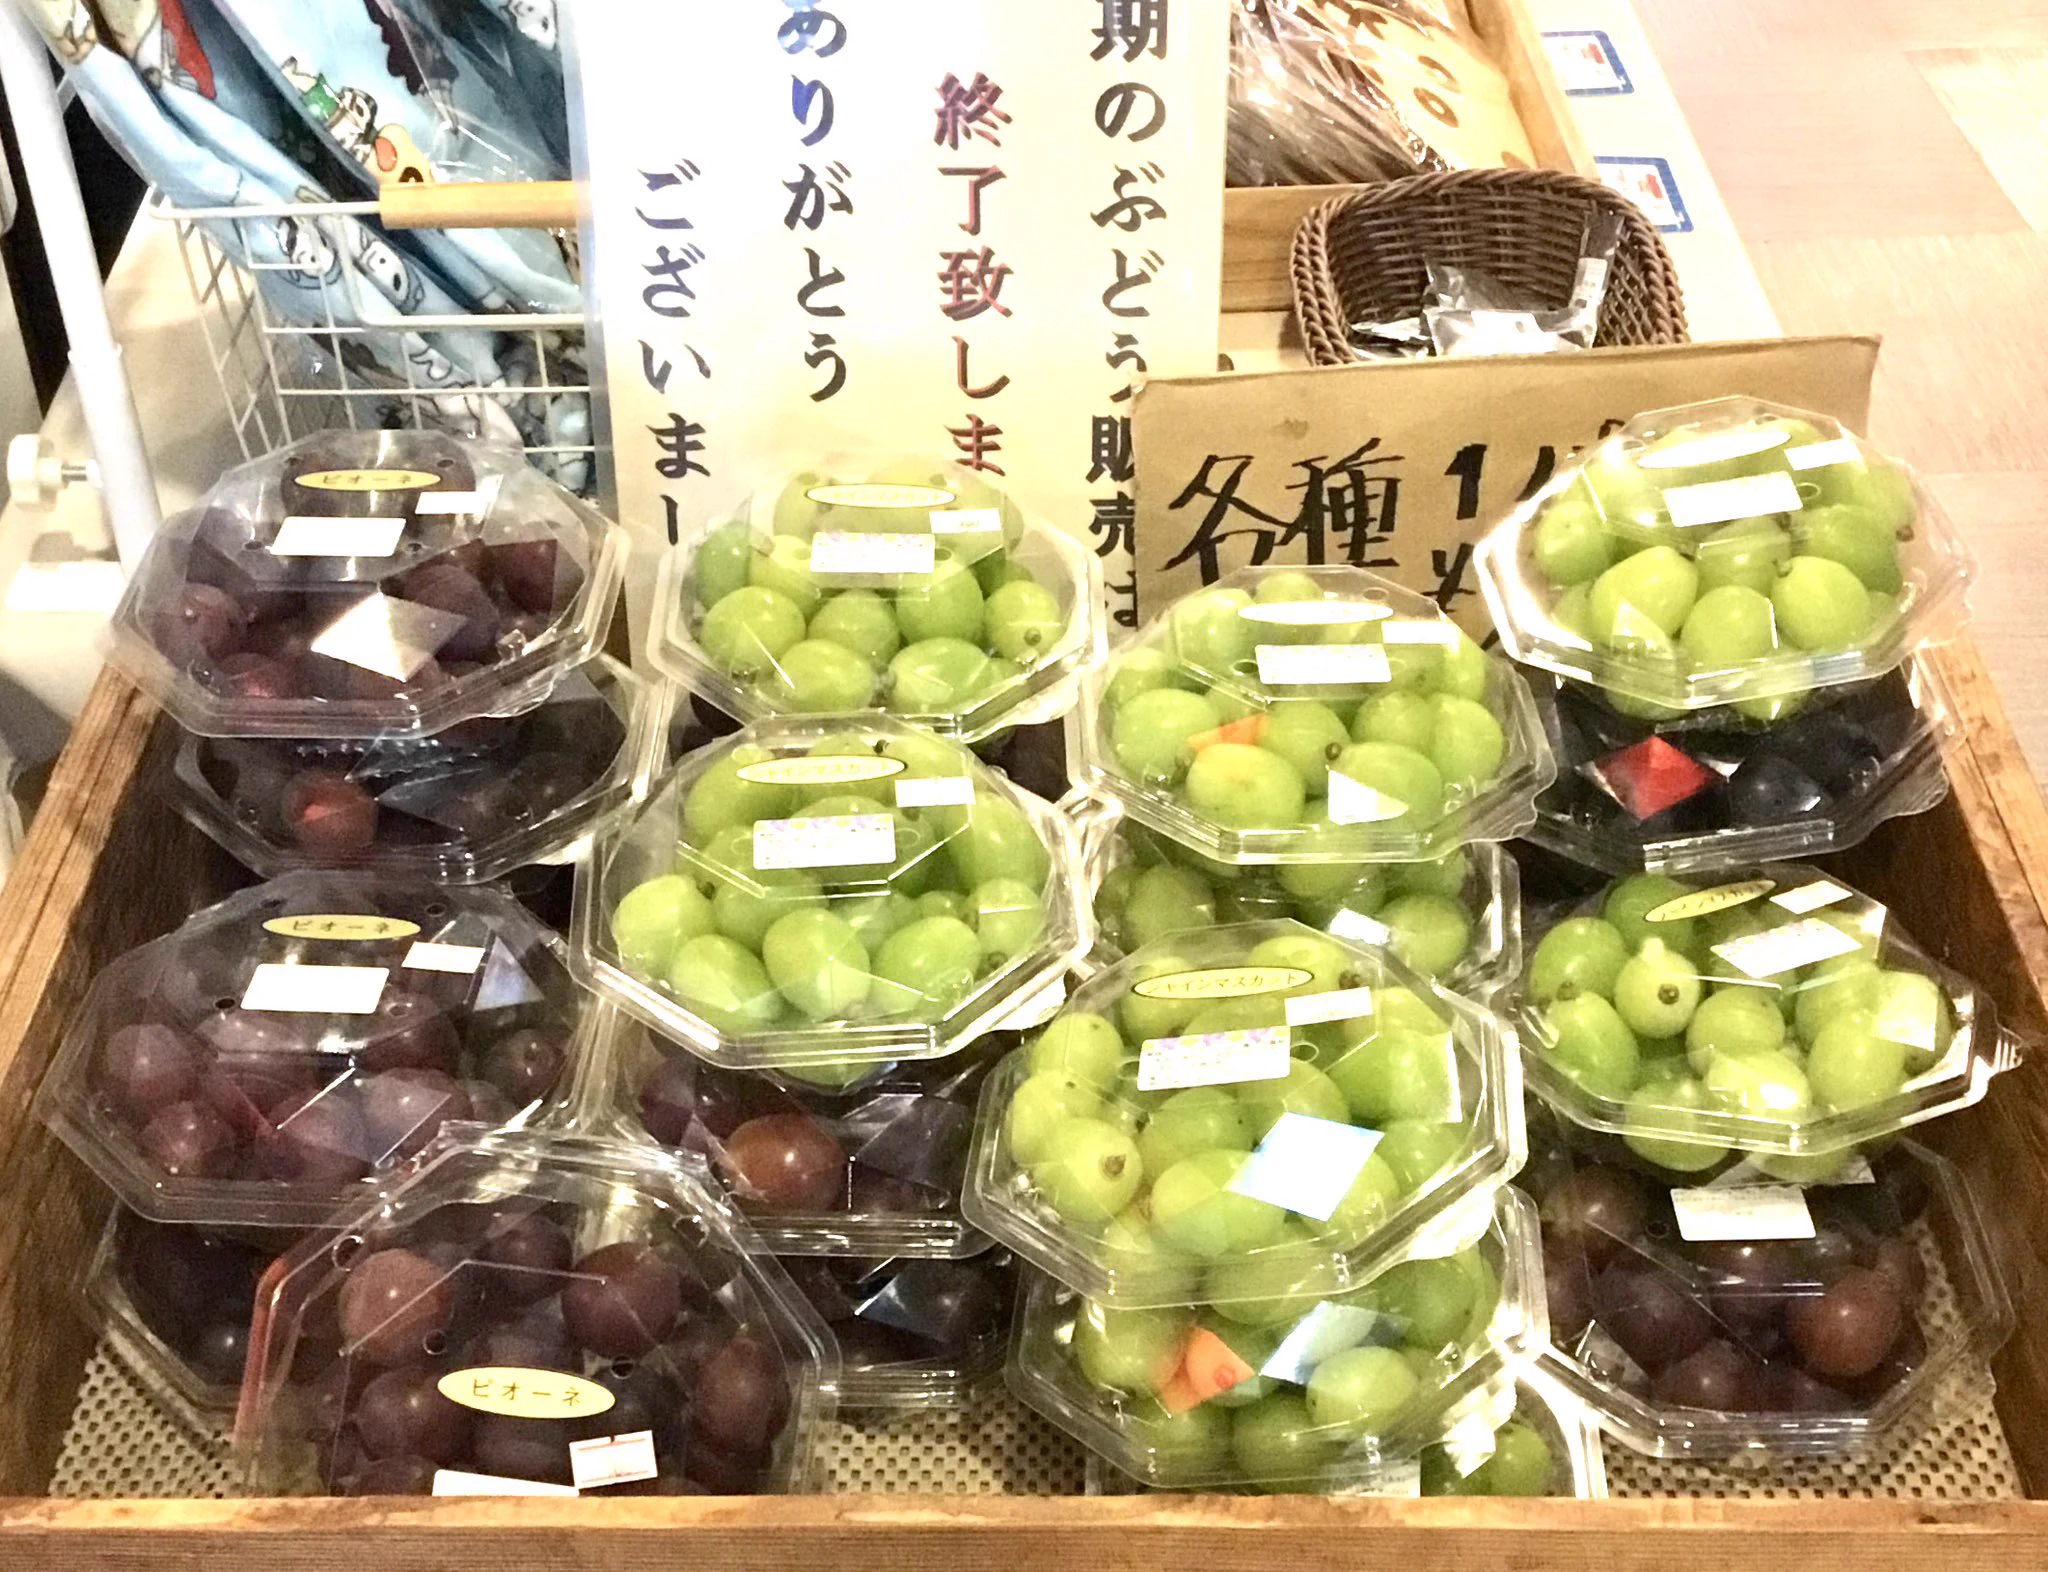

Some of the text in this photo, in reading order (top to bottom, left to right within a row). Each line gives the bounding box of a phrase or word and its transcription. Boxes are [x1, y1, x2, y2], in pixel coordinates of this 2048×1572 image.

[776, 0, 854, 402] ありがとう
[292, 919, 391, 935] ピオーネ
[471, 1377, 582, 1408] ピオーネ
